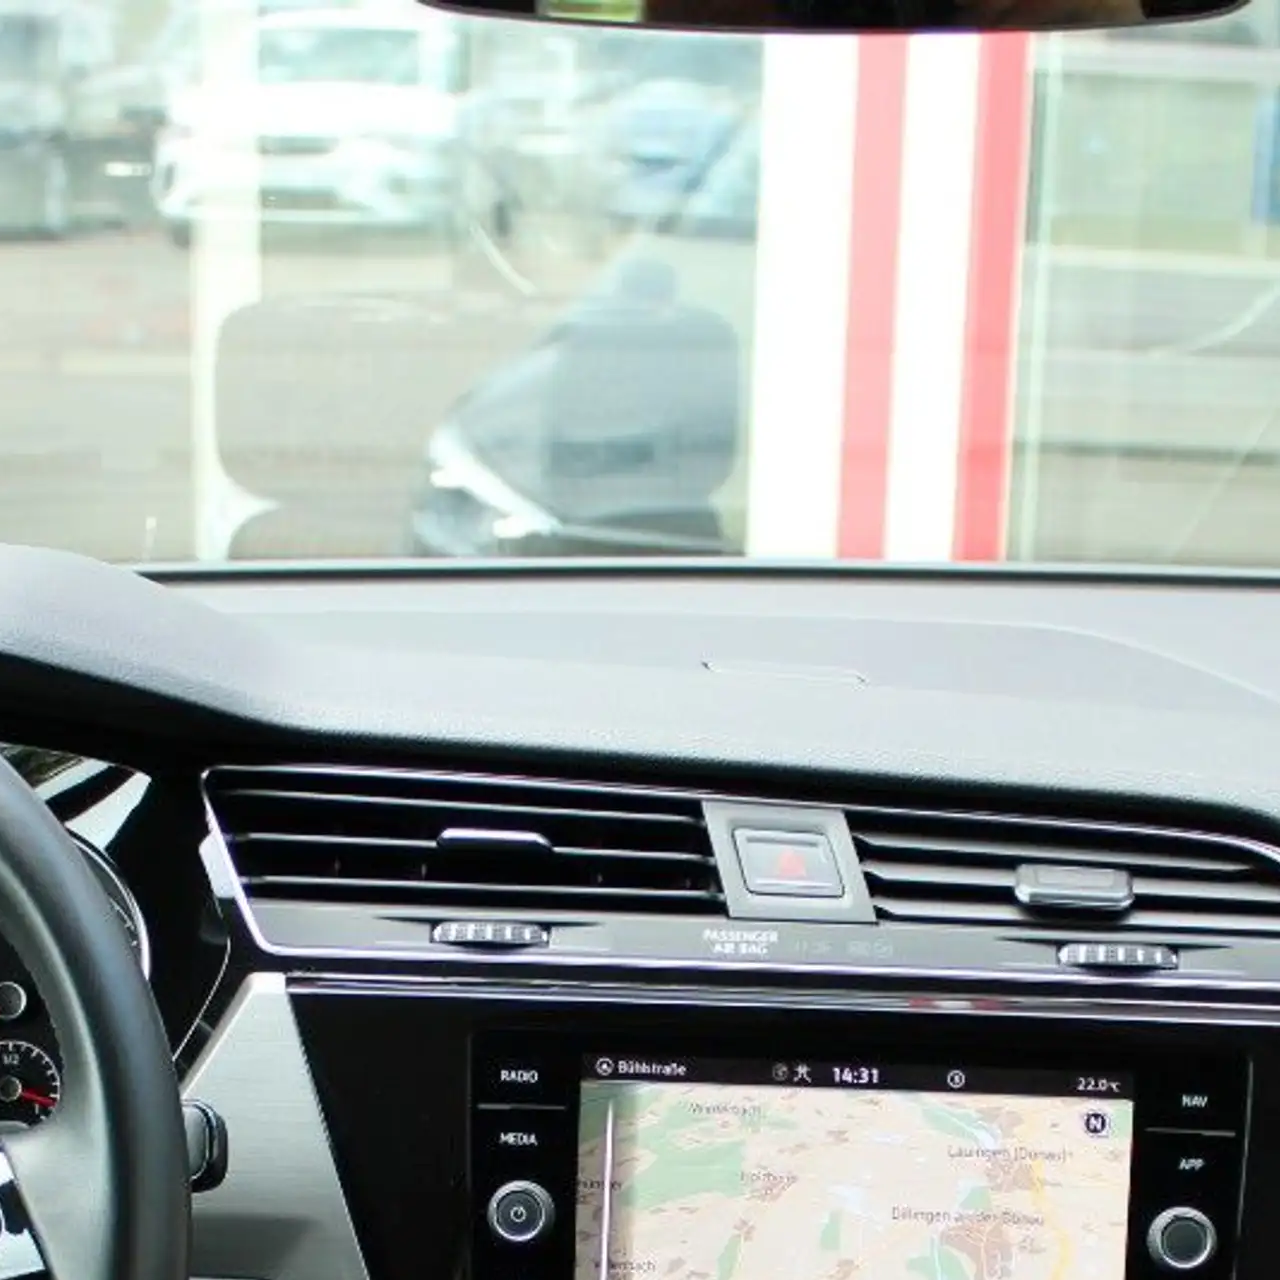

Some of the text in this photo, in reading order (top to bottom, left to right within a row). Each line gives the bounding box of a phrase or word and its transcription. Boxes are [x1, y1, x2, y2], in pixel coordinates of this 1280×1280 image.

[500, 1068, 540, 1084] RADIO
[832, 1066, 881, 1084] 14:31
[1181, 1094, 1209, 1108] NAV
[499, 1131, 539, 1147] MEDIA
[1177, 1158, 1206, 1172] APP
